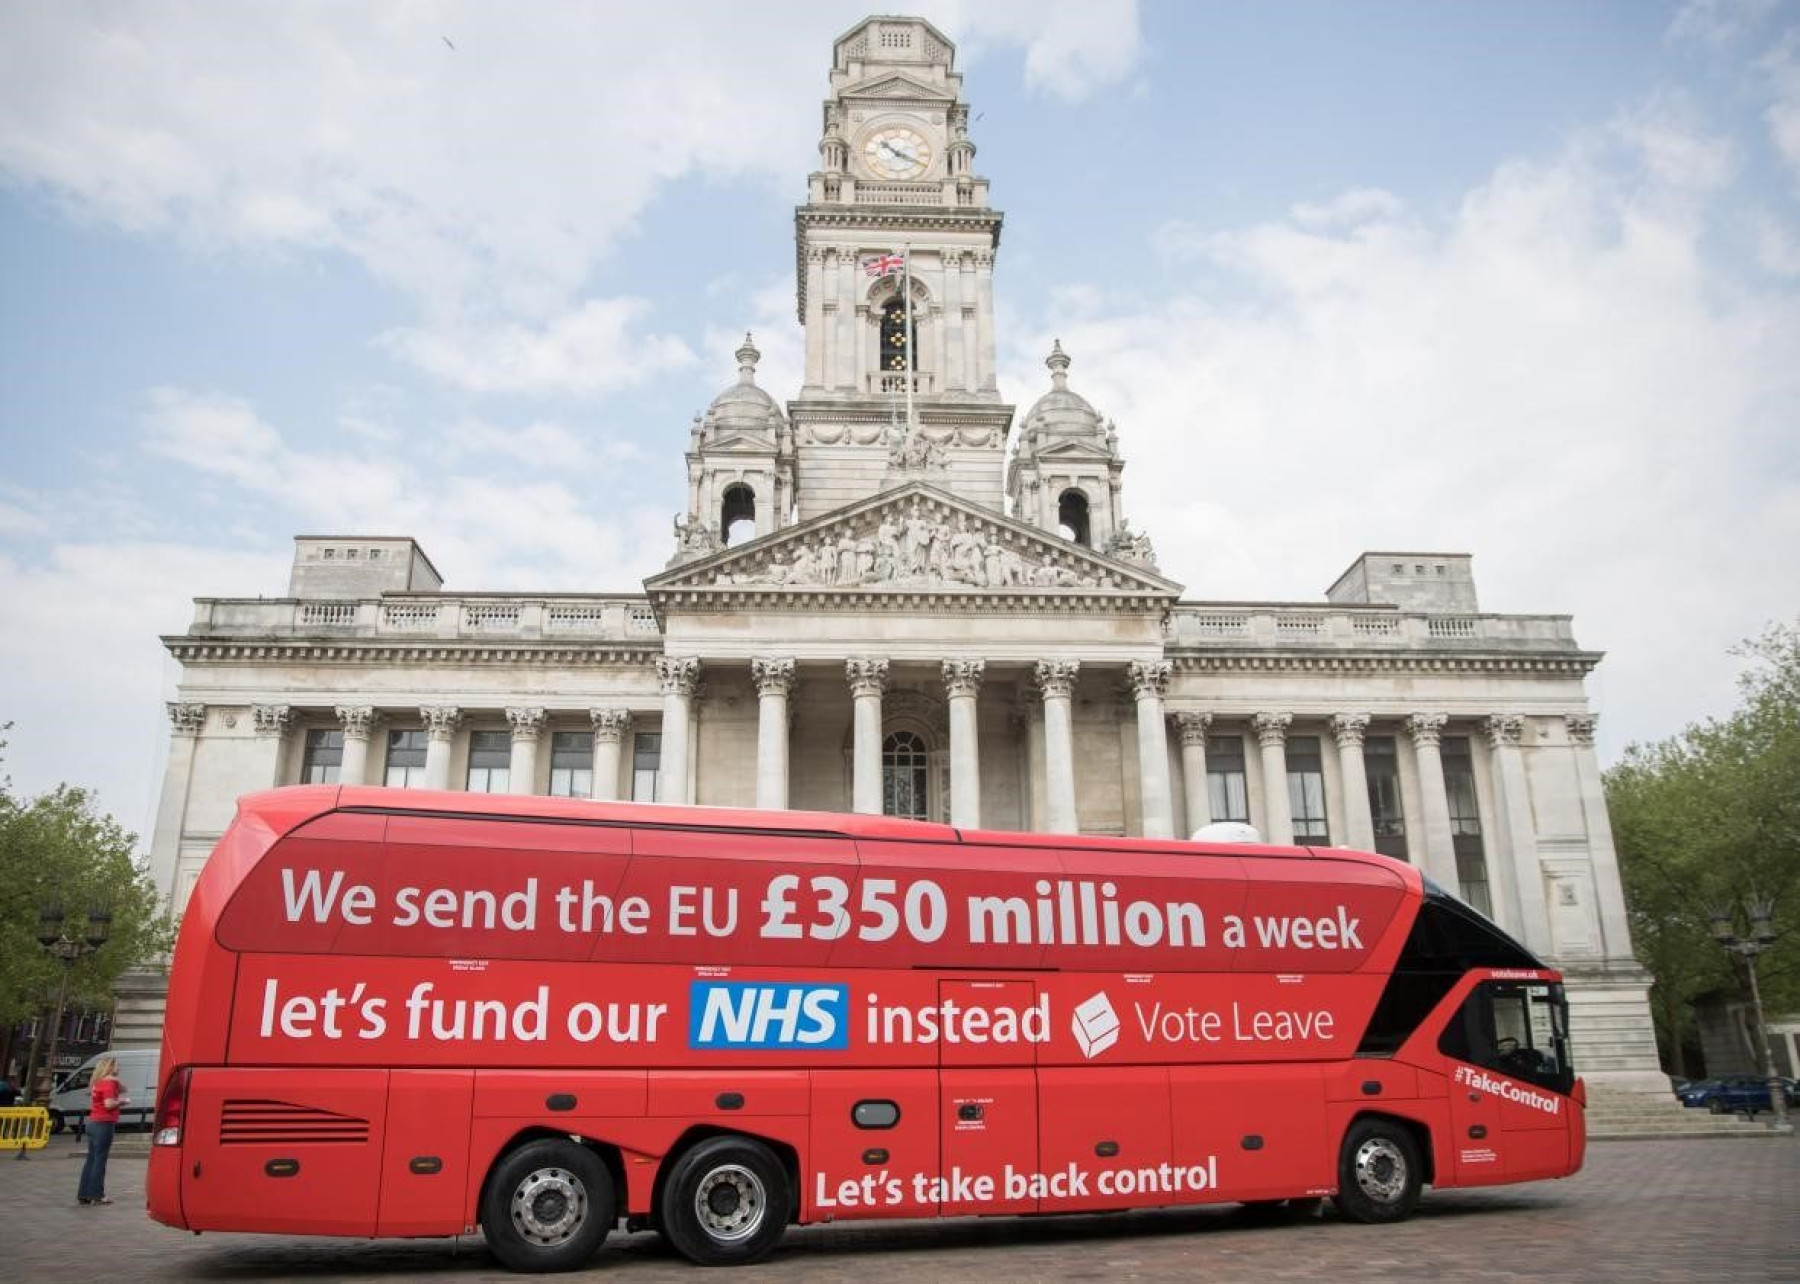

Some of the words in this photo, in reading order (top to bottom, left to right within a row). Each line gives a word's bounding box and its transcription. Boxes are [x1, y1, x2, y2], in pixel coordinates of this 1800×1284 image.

[281, 868, 376, 924] We
[393, 877, 538, 932] send
[555, 879, 651, 935] the
[668, 885, 738, 938] EU
[759, 874, 948, 943] £350
[967, 879, 1206, 948] million
[1222, 914, 1246, 948] a
[1253, 905, 1364, 949] week
[260, 978, 387, 1039] let's
[405, 981, 550, 1041] fund
[566, 1001, 667, 1043] our
[698, 987, 840, 1043] NHS
[866, 992, 1051, 1044] instead
[1134, 1001, 1221, 1042] Vote
[1233, 1001, 1334, 1041] Leave
[1454, 1066, 1559, 1114] #TakeControl
[815, 1169, 904, 1208] Let's
[912, 1165, 995, 1203] take
[1003, 1163, 1088, 1199] back
[1097, 1155, 1218, 1195] control
